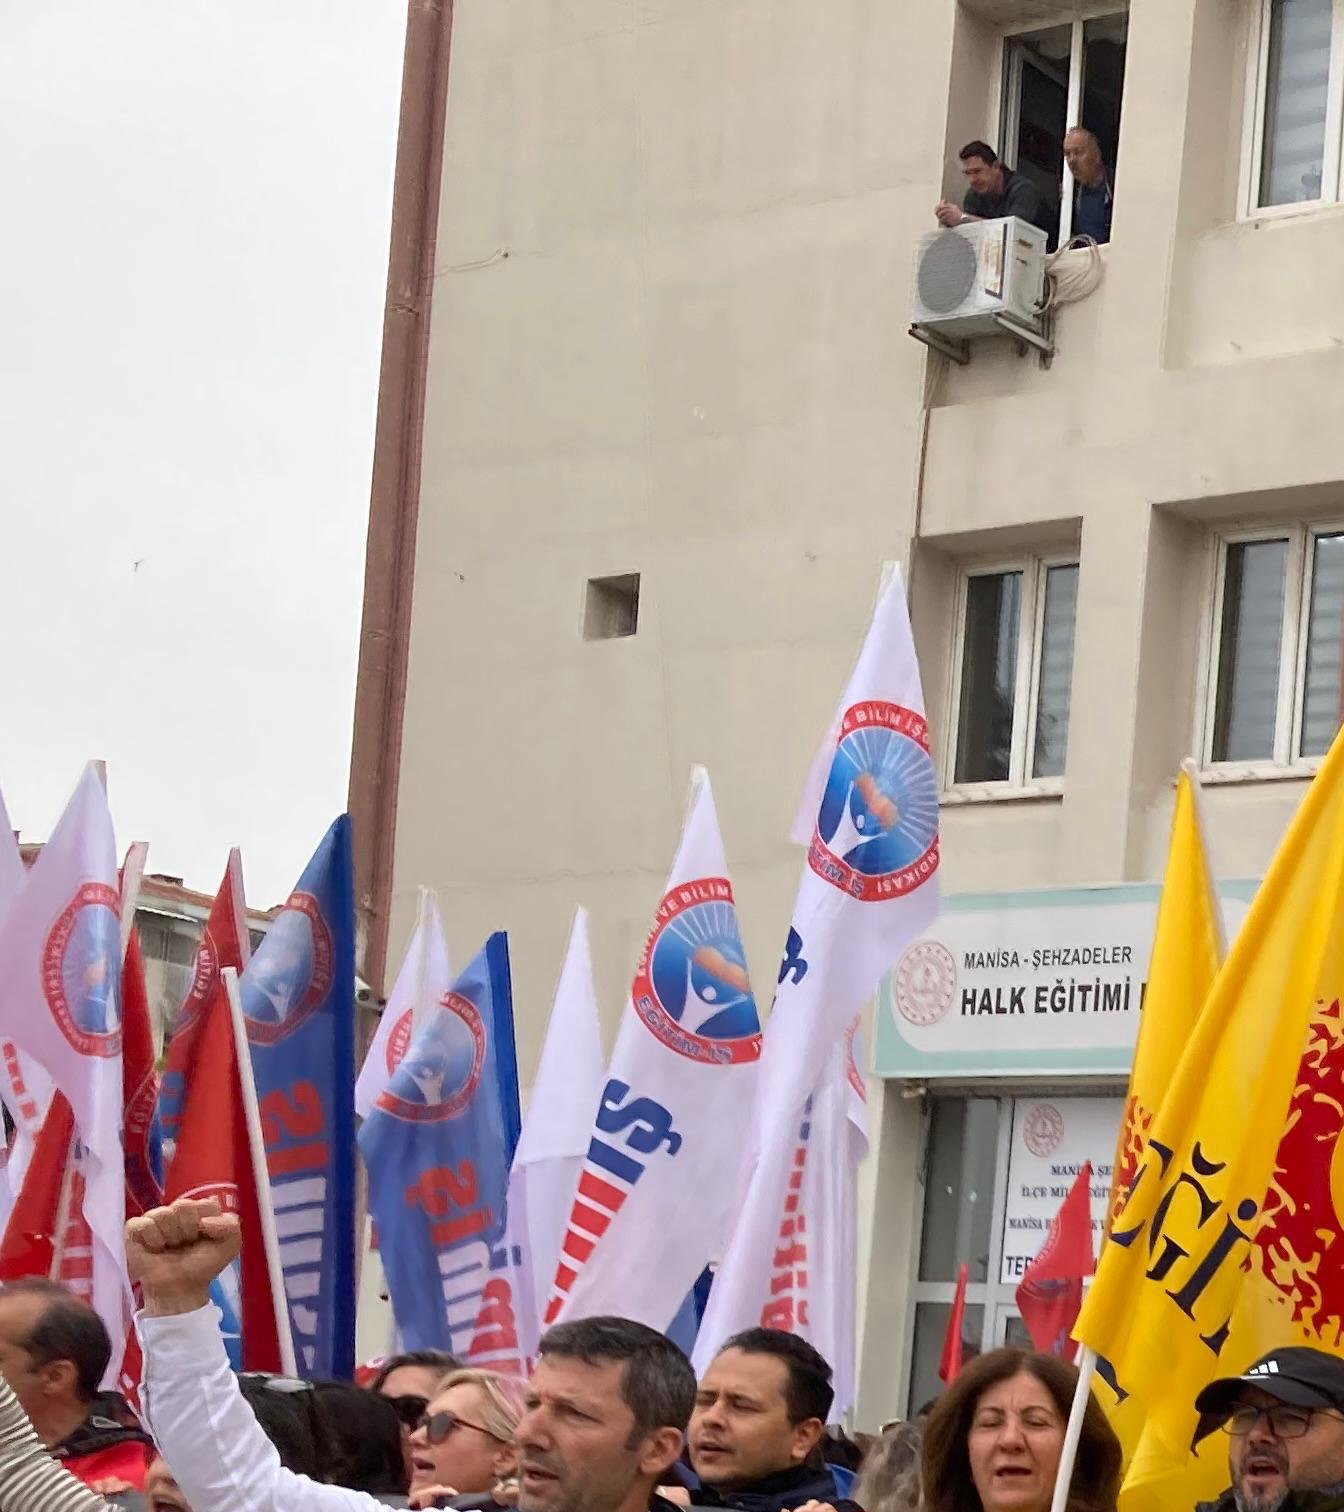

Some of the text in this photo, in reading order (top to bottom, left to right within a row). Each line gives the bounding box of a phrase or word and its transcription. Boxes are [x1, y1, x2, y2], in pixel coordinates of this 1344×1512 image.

[964, 948, 1020, 970] MANİSA
[1032, 946, 1132, 971] ŞEHZADELER
[961, 986, 1027, 1016] HALK
[1034, 975, 1132, 1015] EĞİTİMİ
